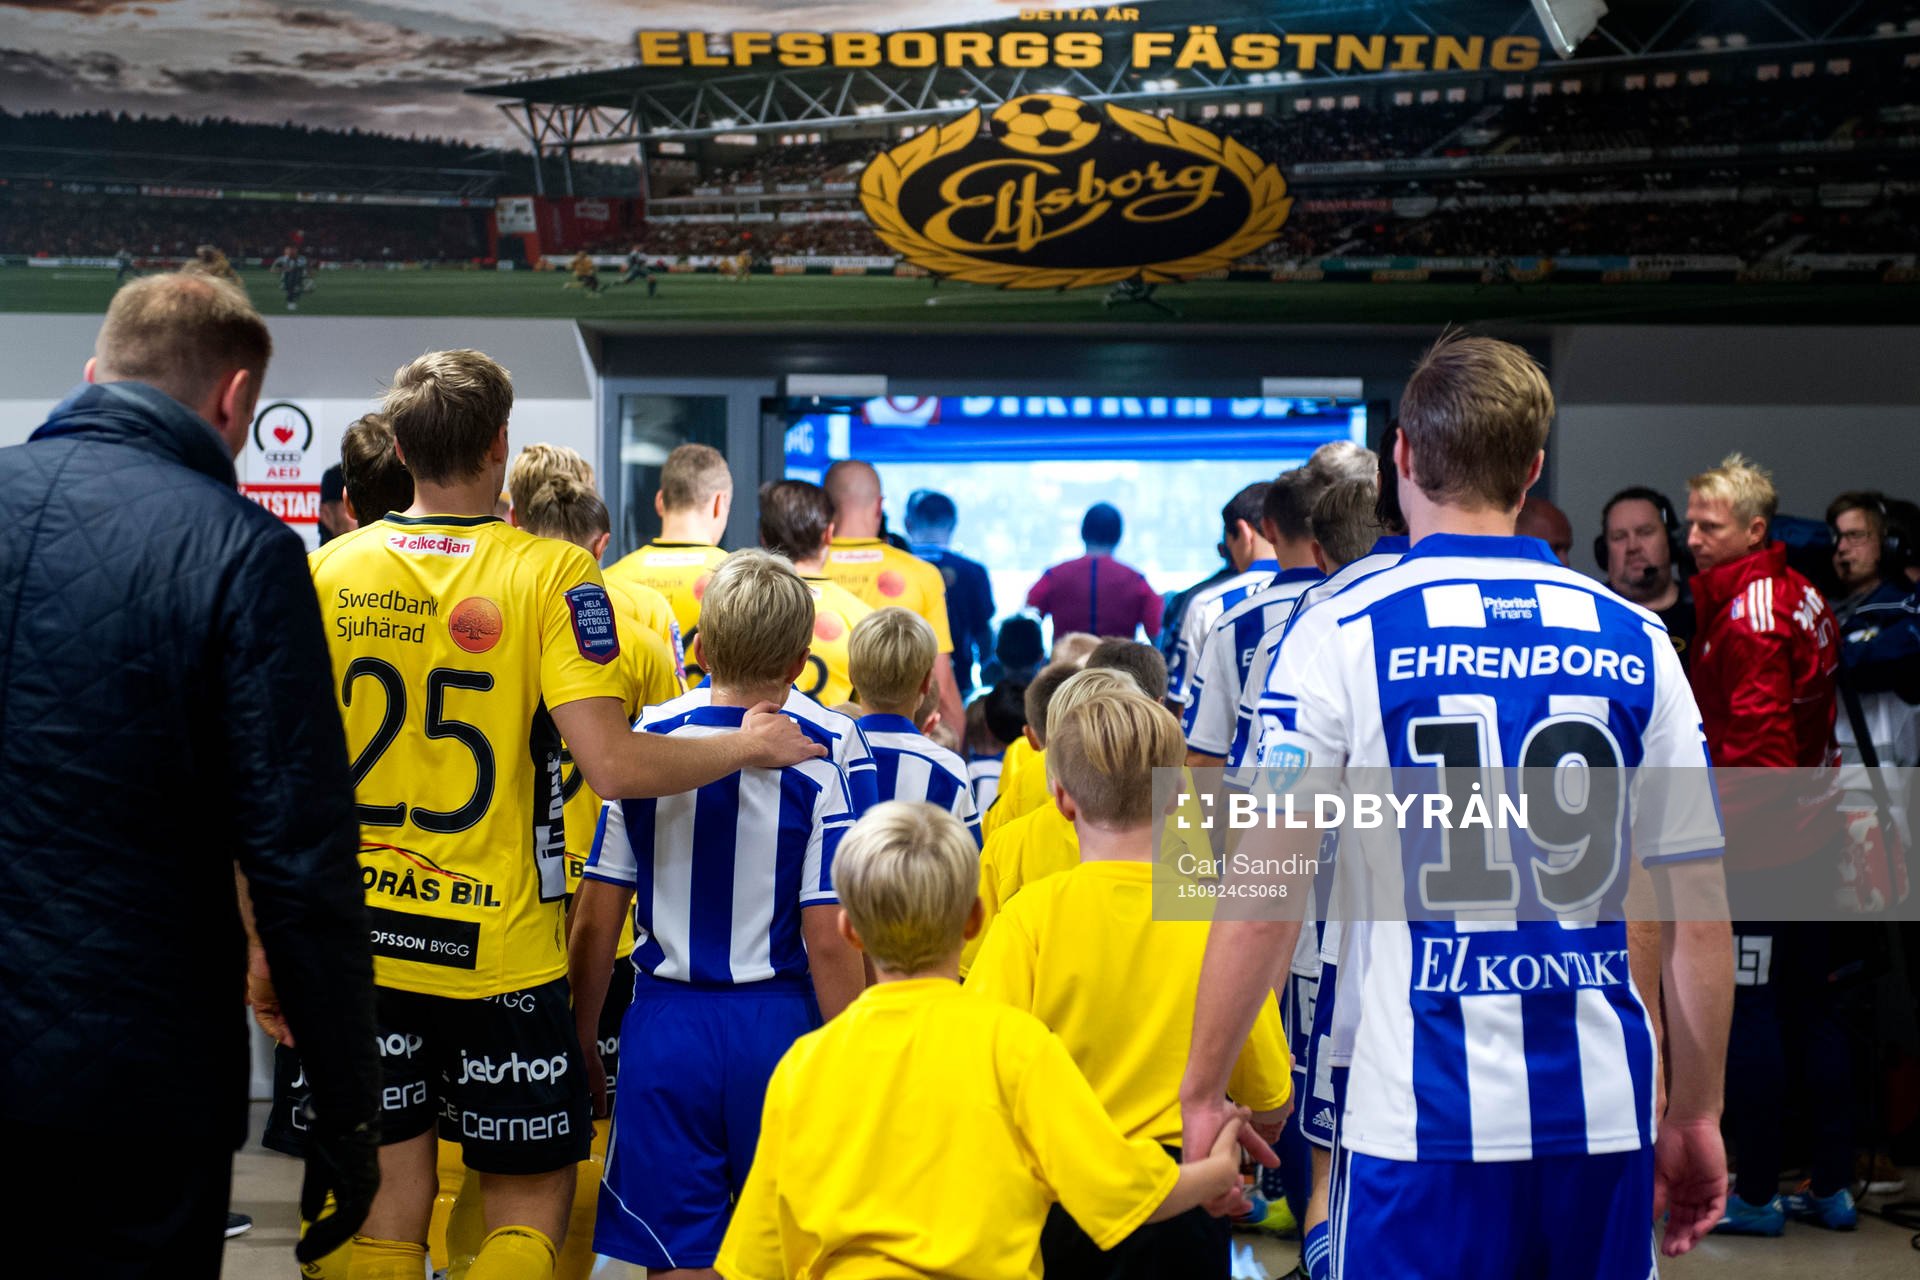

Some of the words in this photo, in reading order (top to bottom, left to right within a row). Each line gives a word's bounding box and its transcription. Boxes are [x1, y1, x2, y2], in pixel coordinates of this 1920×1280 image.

[1020, 8, 1099, 21] DETTA
[638, 30, 1104, 68] ELFSBORGS
[1132, 26, 1541, 71] FÄSTNING
[923, 157, 1225, 253] Elfsborg
[267, 467, 301, 478] AED
[338, 588, 439, 617] Swedbank
[578, 608, 609, 618] SVERIGES
[584, 600, 600, 608] HELA
[1483, 597, 1538, 609] Prioritet
[337, 615, 426, 643] Sjuhärad
[578, 617, 611, 627] FOTBOLLS
[1388, 643, 1647, 686] EHRENBORG
[341, 656, 497, 835] 25
[1406, 712, 1627, 914] 19
[361, 866, 441, 903] ORÅS
[450, 881, 501, 908] BIL
[370, 930, 426, 951] OFSSON
[430, 940, 470, 957] BYGG
[1414, 935, 1471, 993] El
[457, 1050, 568, 1085] jetshop
[463, 1111, 571, 1142] Cernera
